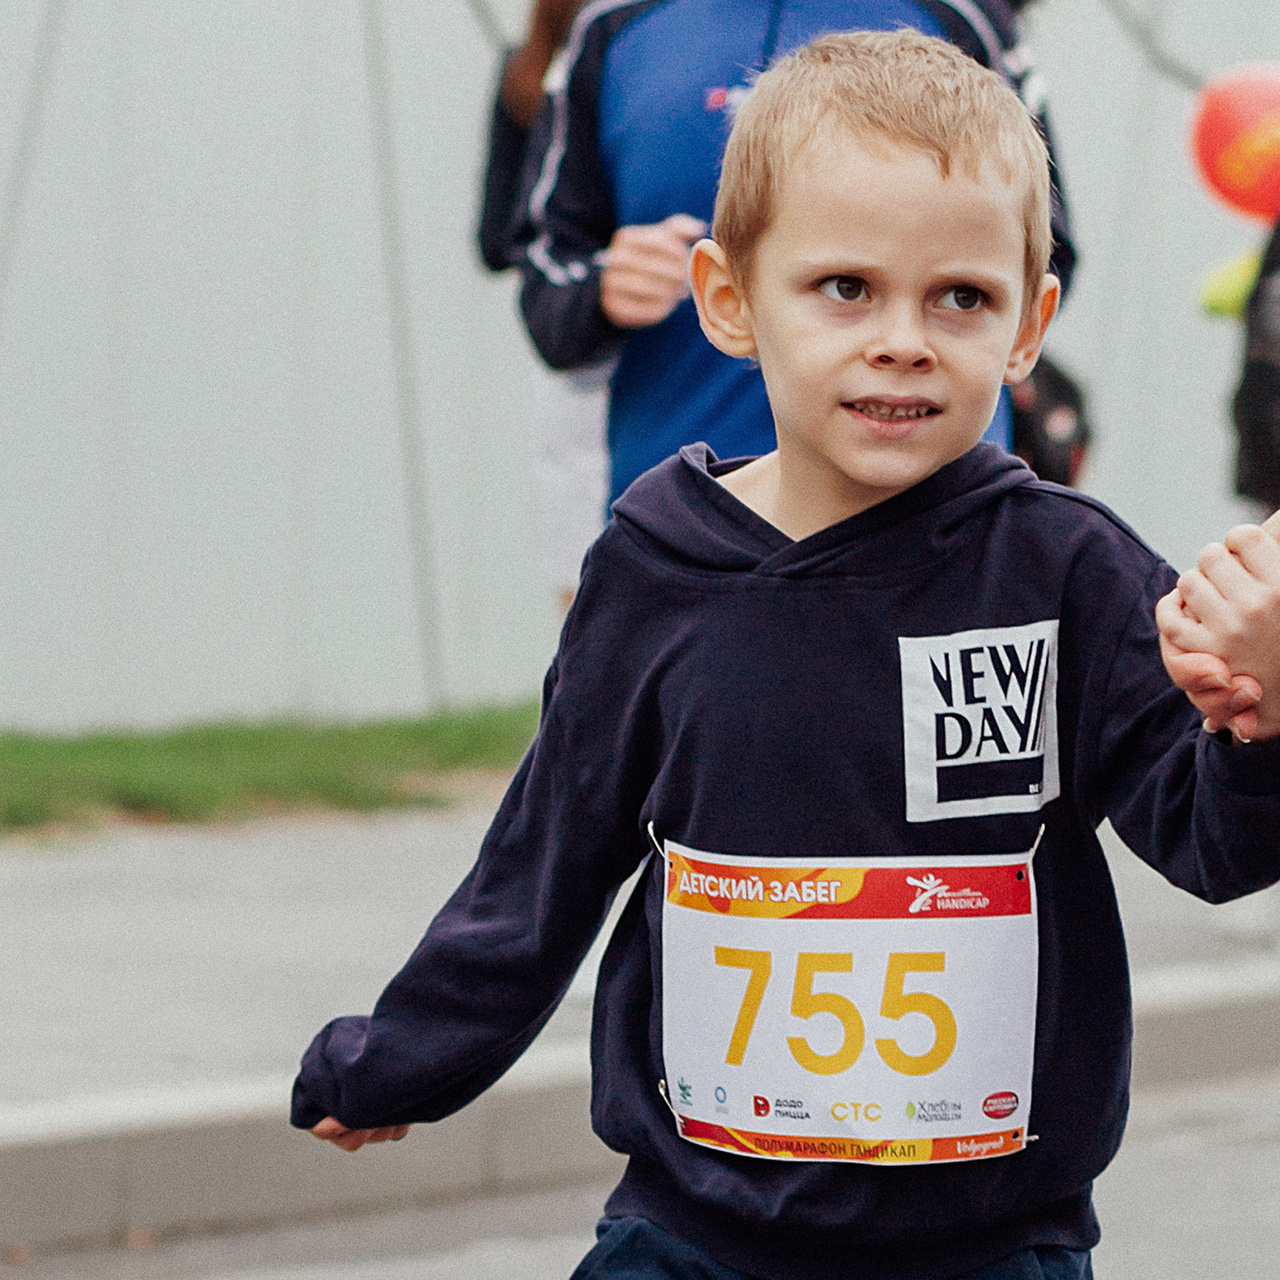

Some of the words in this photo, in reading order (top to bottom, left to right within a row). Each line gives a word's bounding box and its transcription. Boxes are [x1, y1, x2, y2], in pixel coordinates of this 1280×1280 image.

[929, 638, 1045, 707] NEW
[934, 704, 1038, 761] DAY
[678, 870, 764, 903] ДЕТСКИЙ
[769, 880, 842, 904] ЗАБЕГ
[937, 897, 990, 910] HANDICAP
[713, 945, 958, 1077] 755
[774, 1098, 803, 1108] ДОДО
[774, 1109, 811, 1120] ПИЦЦА
[754, 1137, 847, 1154] ПОЛУМАРАФОН
[850, 1143, 917, 1159] ГАНДИКАП
